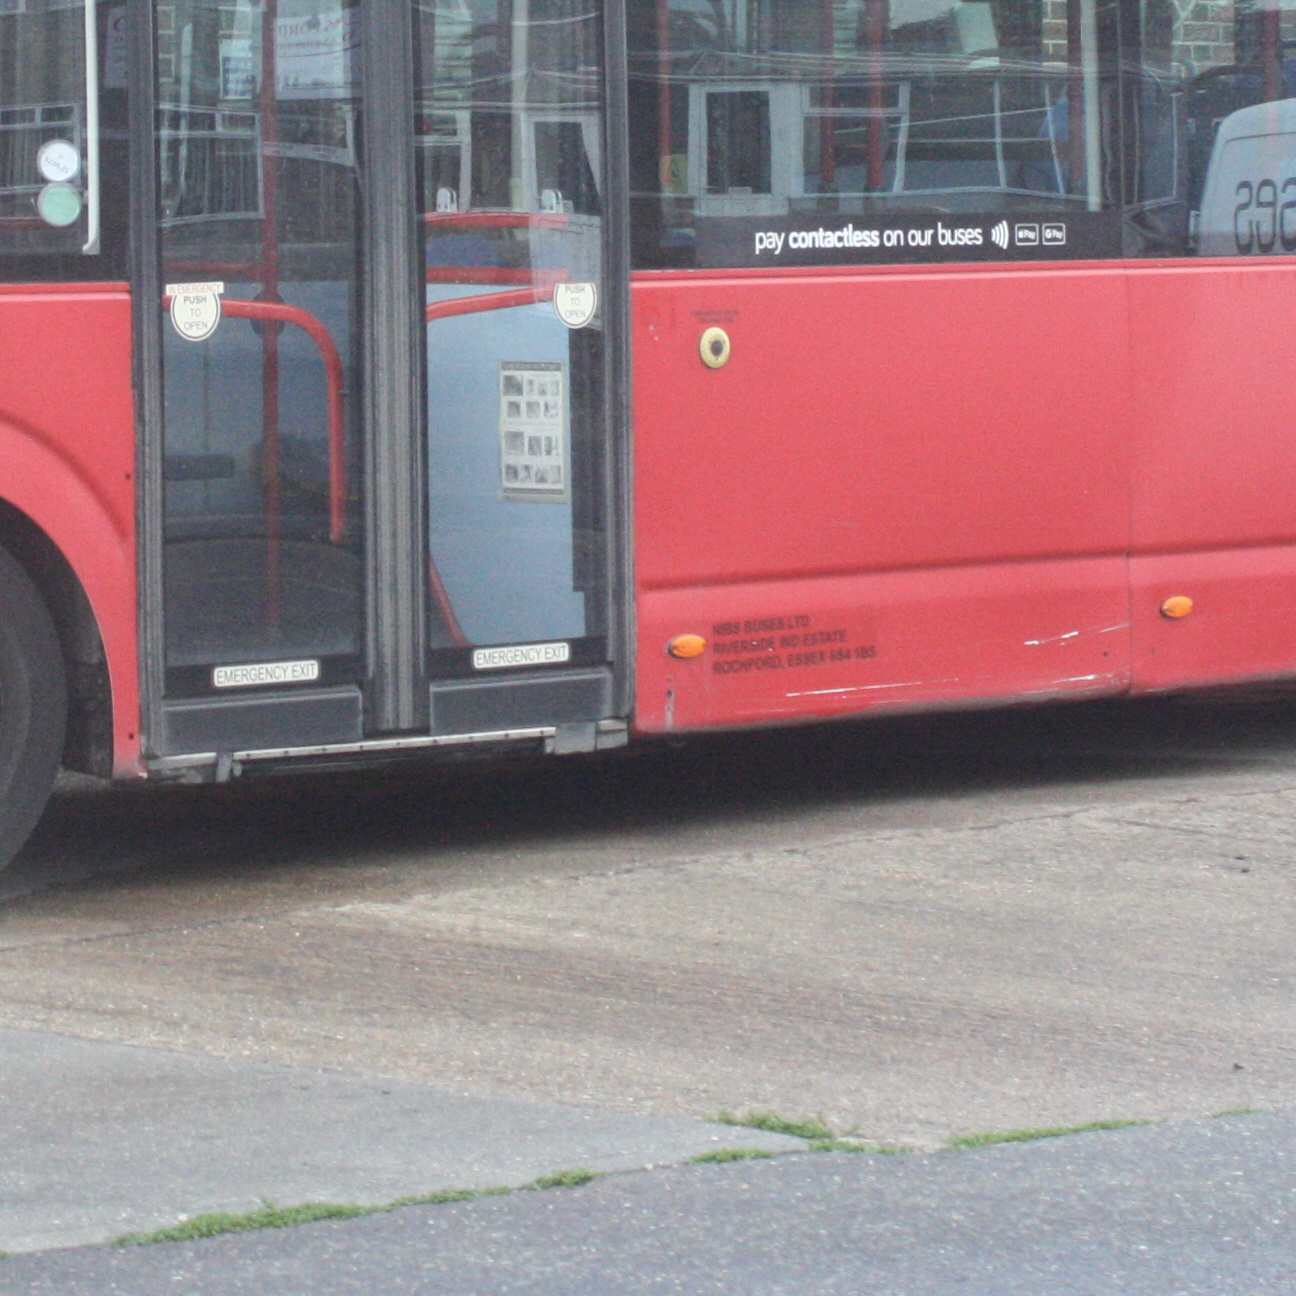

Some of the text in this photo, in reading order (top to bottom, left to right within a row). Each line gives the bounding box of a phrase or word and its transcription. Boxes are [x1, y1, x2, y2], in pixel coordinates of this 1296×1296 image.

[755, 222, 982, 254] pay contactless on our buses
[177, 284, 220, 294] EMERGENCY
[565, 285, 586, 293] PUSH
[184, 296, 206, 304] PUSH
[570, 297, 580, 306] TO
[190, 308, 201, 317] TO
[565, 309, 586, 318] OPEN
[184, 321, 207, 330] OPEN
[712, 615, 809, 635] NIBS BUSES LTD
[712, 637, 775, 654] RIVERSIDE
[803, 629, 847, 646] ESTATE
[475, 645, 568, 667] EMERGENCY EXIT
[787, 650, 825, 667] ESSEX
[216, 662, 317, 684] EMERGENCY EXIT
